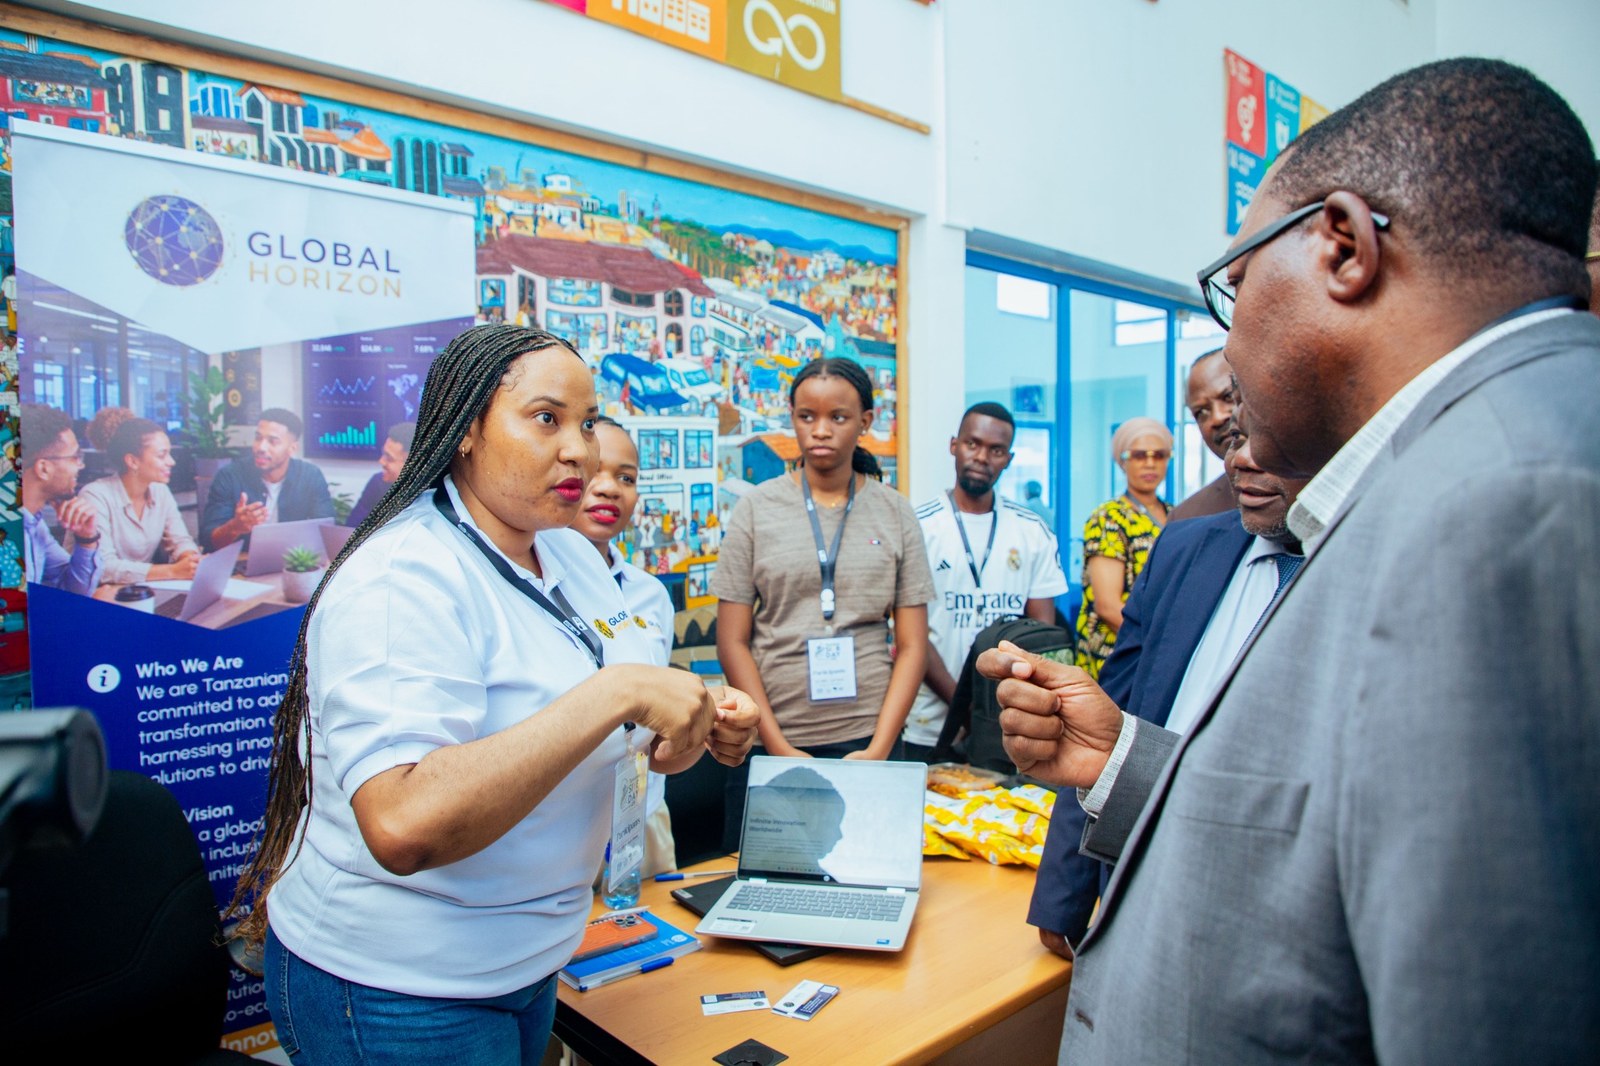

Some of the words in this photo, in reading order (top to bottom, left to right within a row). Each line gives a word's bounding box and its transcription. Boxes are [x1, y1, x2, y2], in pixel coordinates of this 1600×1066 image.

[247, 231, 400, 273] GLOBAL
[249, 260, 401, 298] HORIZON
[945, 591, 1023, 611] Emrates
[135, 662, 177, 679] Who
[181, 658, 209, 674] We
[213, 655, 244, 671] Are
[136, 685, 165, 701] We
[168, 682, 199, 697] are
[202, 672, 289, 693] Tanzanian
[137, 696, 233, 723] committed
[236, 696, 254, 710] to
[138, 717, 266, 744] transformation
[139, 741, 233, 767] harnessing
[150, 765, 216, 785] olutions
[219, 761, 237, 776] to
[182, 804, 234, 823] Vision
[198, 830, 211, 842] a
[213, 815, 266, 843] global
